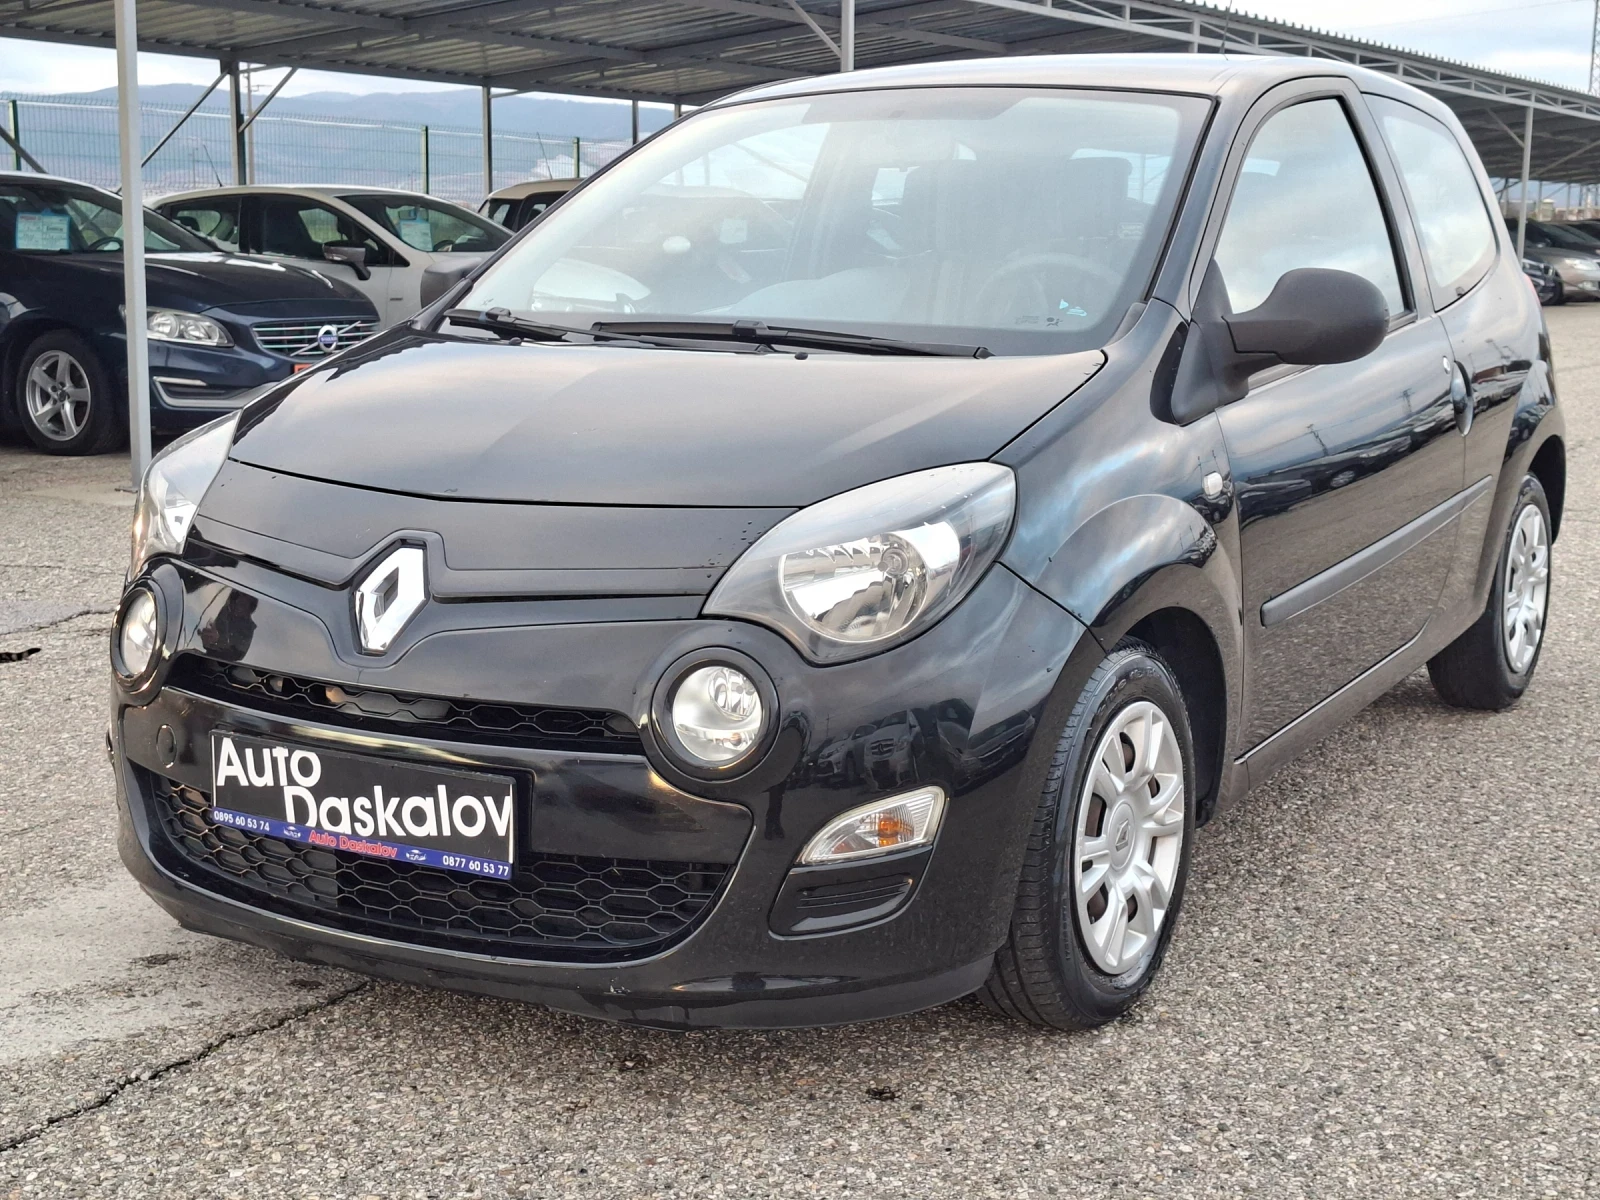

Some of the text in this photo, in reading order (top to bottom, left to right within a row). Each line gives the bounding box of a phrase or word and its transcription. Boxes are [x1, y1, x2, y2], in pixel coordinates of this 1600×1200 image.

[217, 737, 321, 787] Auto
[214, 811, 270, 831] 0895 60 53 74
[284, 785, 511, 838] Daskalov
[309, 830, 398, 858] Auto Daskalov
[442, 855, 509, 876] 0877 60 53 77
